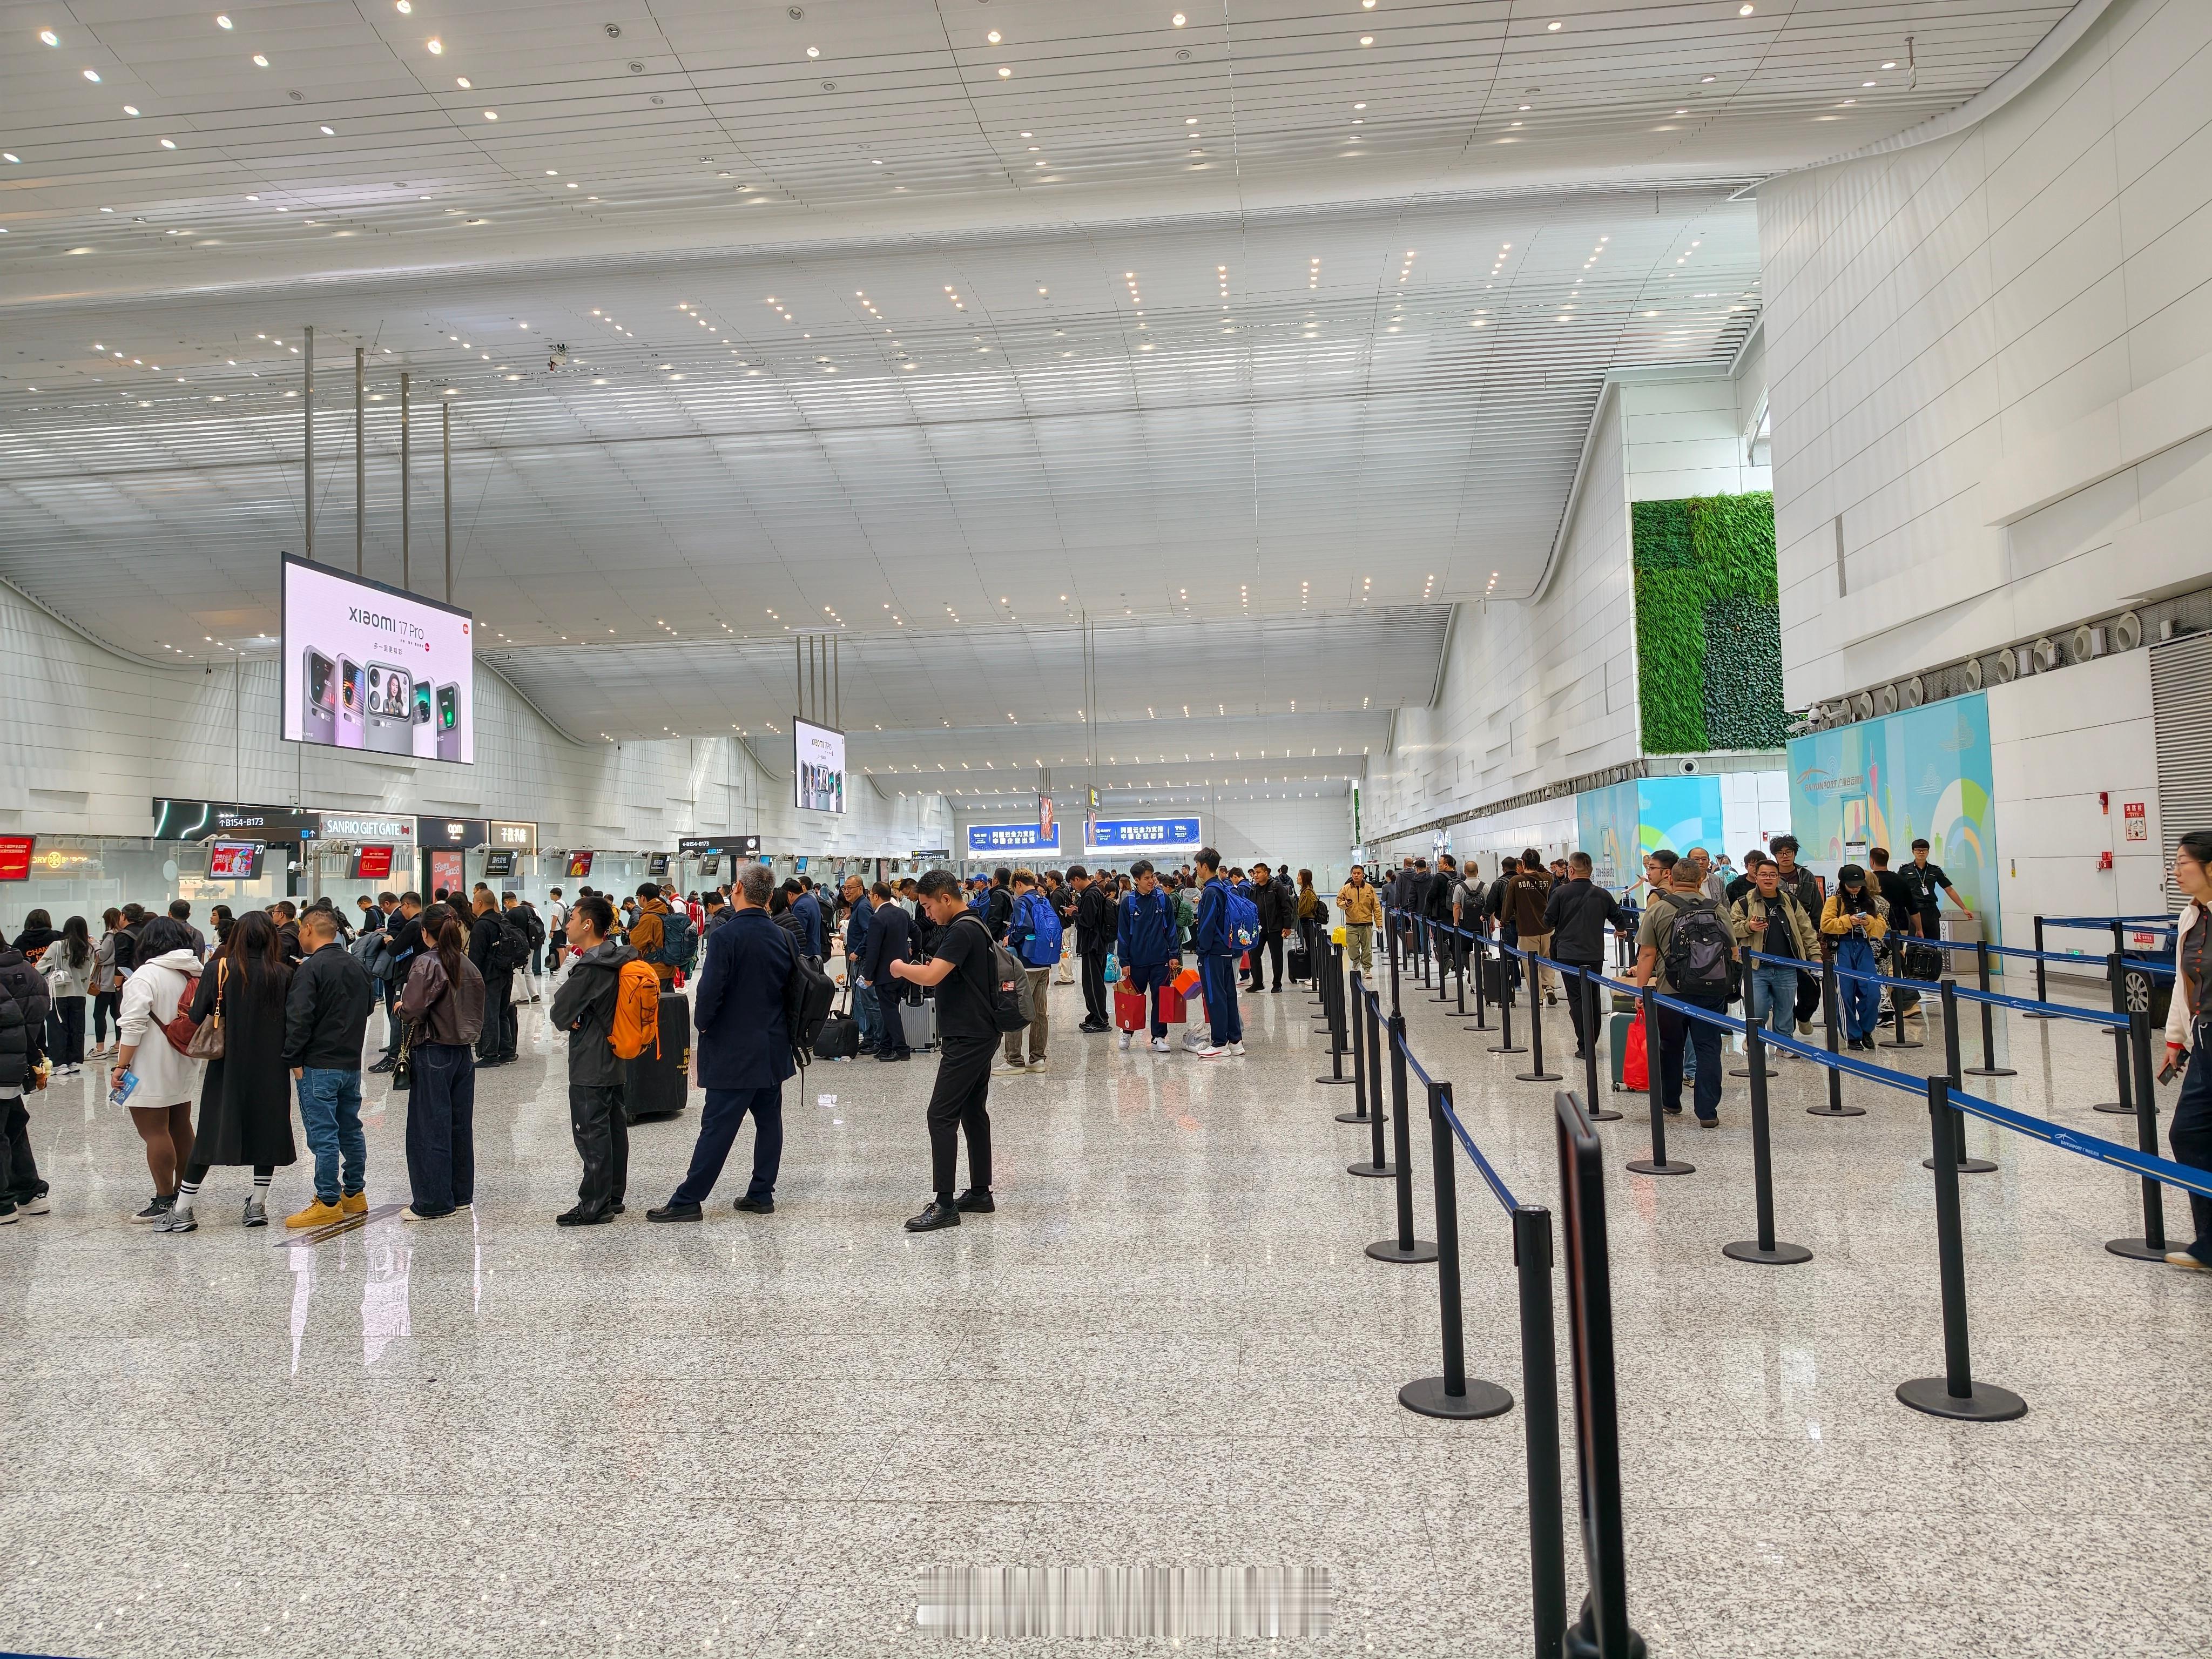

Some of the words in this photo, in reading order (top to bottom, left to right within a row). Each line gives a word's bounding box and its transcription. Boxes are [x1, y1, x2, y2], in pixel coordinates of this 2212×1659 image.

[349, 606, 395, 632] xiaomi
[399, 621, 408, 635] 17
[409, 624, 424, 640] Pro
[1805, 779, 1837, 792] BAIYUNPORT
[225, 818, 264, 827] B154-B173
[327, 819, 360, 834] SANRIO
[360, 821, 379, 835] GIFT
[379, 822, 400, 836] GATE
[1120, 825, 1164, 834] 阿里云全力支持
[992, 830, 1035, 838] 阿里云全力支持
[1121, 832, 1164, 840] 中国企业出海
[254, 845, 265, 854] 27
[354, 848, 361, 857] 28
[26, 946, 49, 956] CHAN
